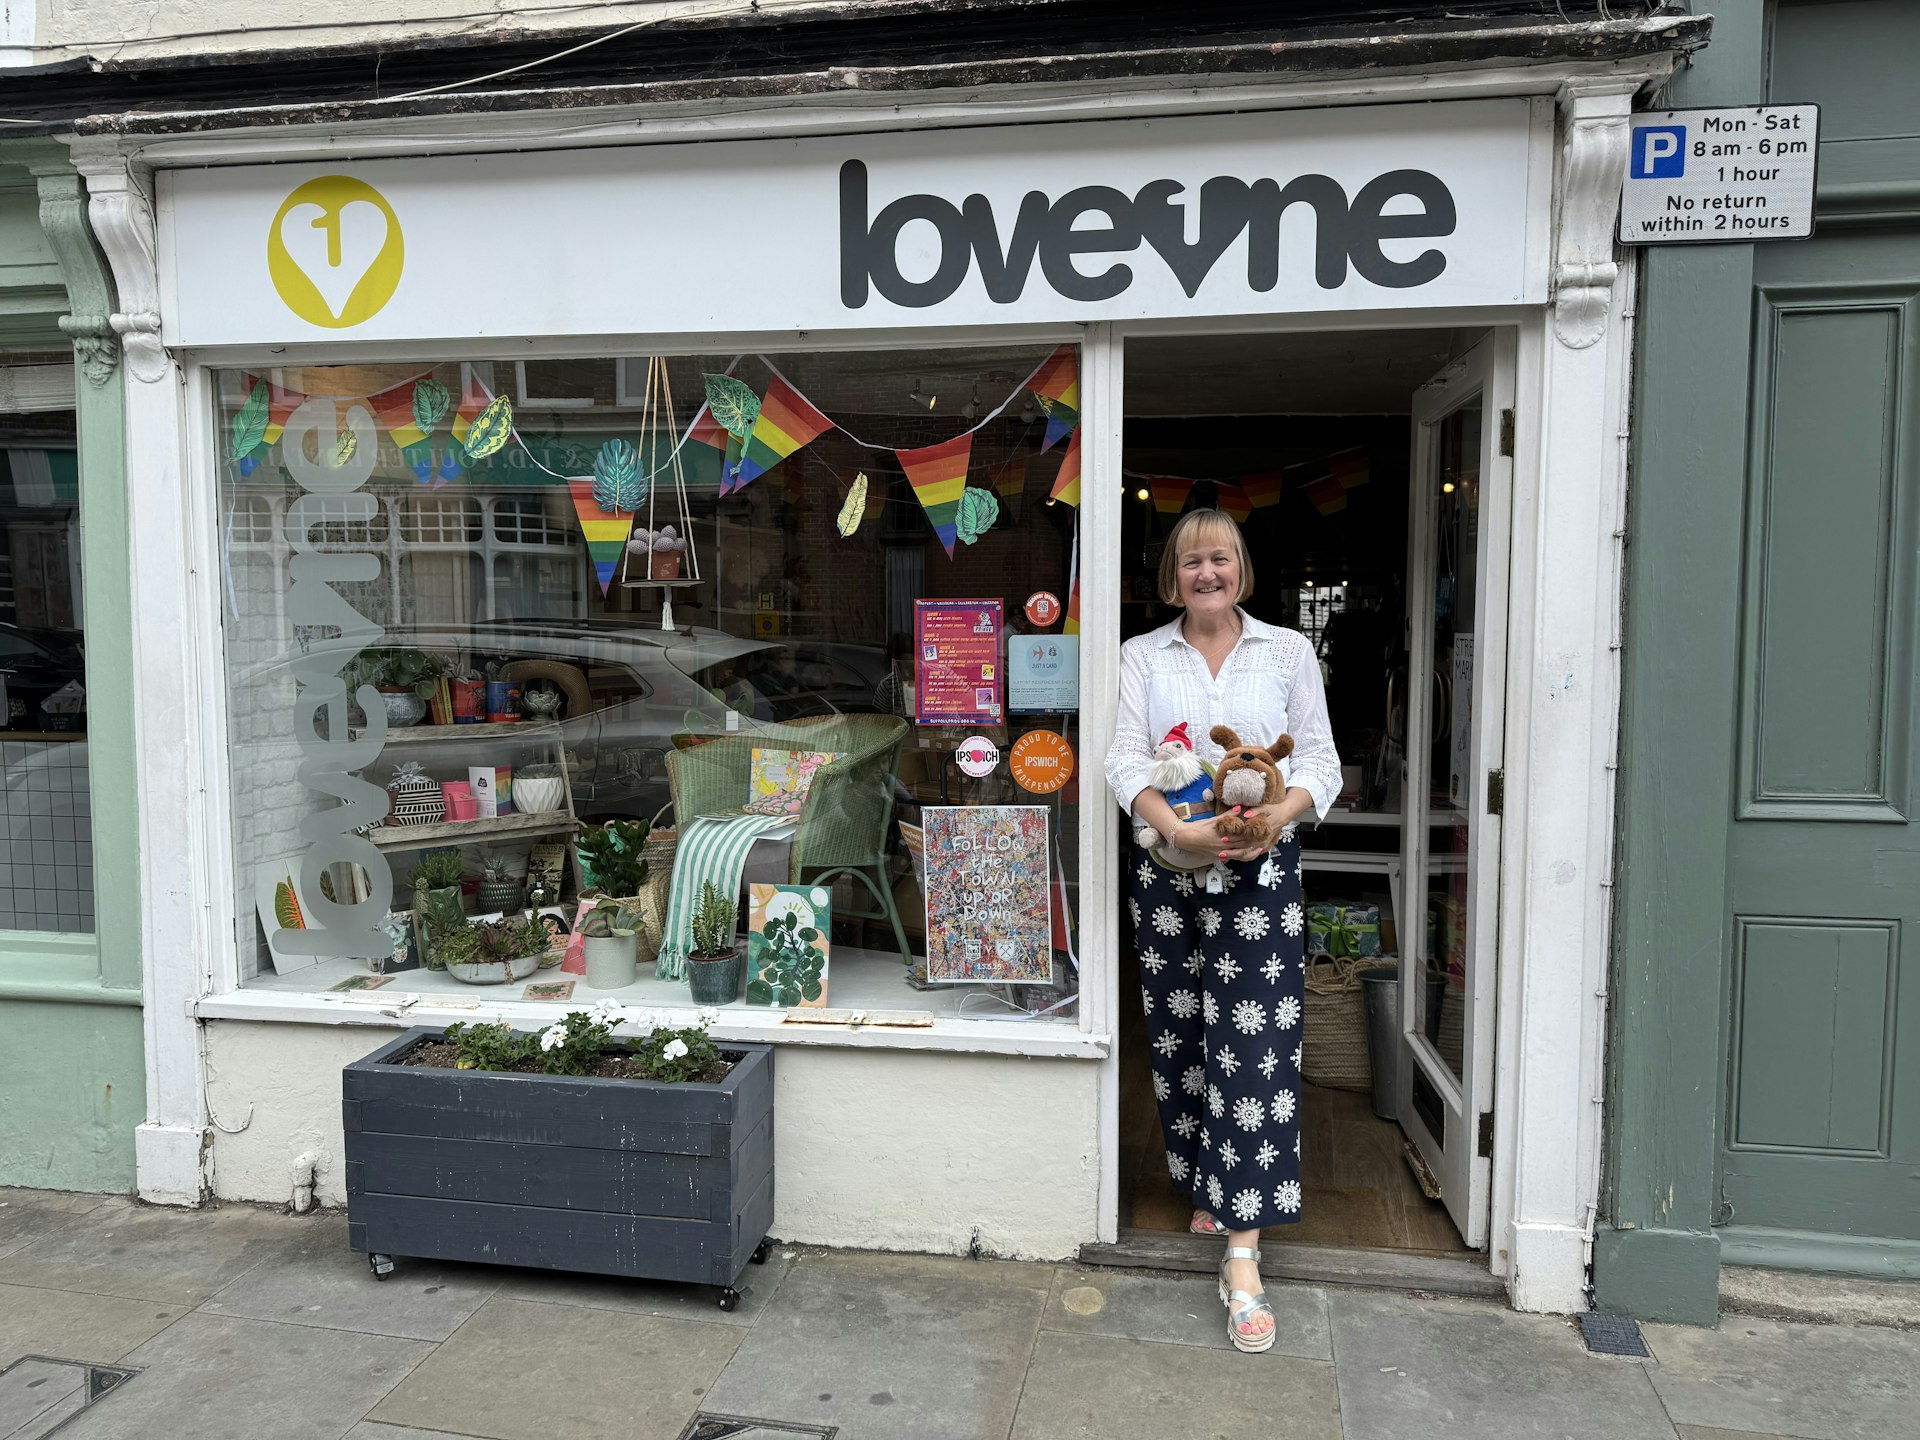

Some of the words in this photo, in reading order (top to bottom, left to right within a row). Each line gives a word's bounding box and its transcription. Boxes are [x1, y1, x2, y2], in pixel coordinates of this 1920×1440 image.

[1703, 117, 1746, 133] Mon
[1765, 114, 1800, 130] Sat
[1644, 132, 1678, 174] P
[1717, 167, 1724, 182] 1
[1733, 166, 1780, 182] hour
[1667, 195, 1695, 211] No
[1702, 194, 1767, 210] return
[1641, 216, 1703, 232] within
[1714, 215, 1726, 230] 2
[1732, 214, 1790, 230] hours
[1014, 733, 1041, 757] PROUD
[1046, 734, 1058, 745] TO
[1058, 744, 1070, 757] BE
[1025, 756, 1058, 767] IPSWICH
[1013, 764, 1070, 791] INDEPENDENT
